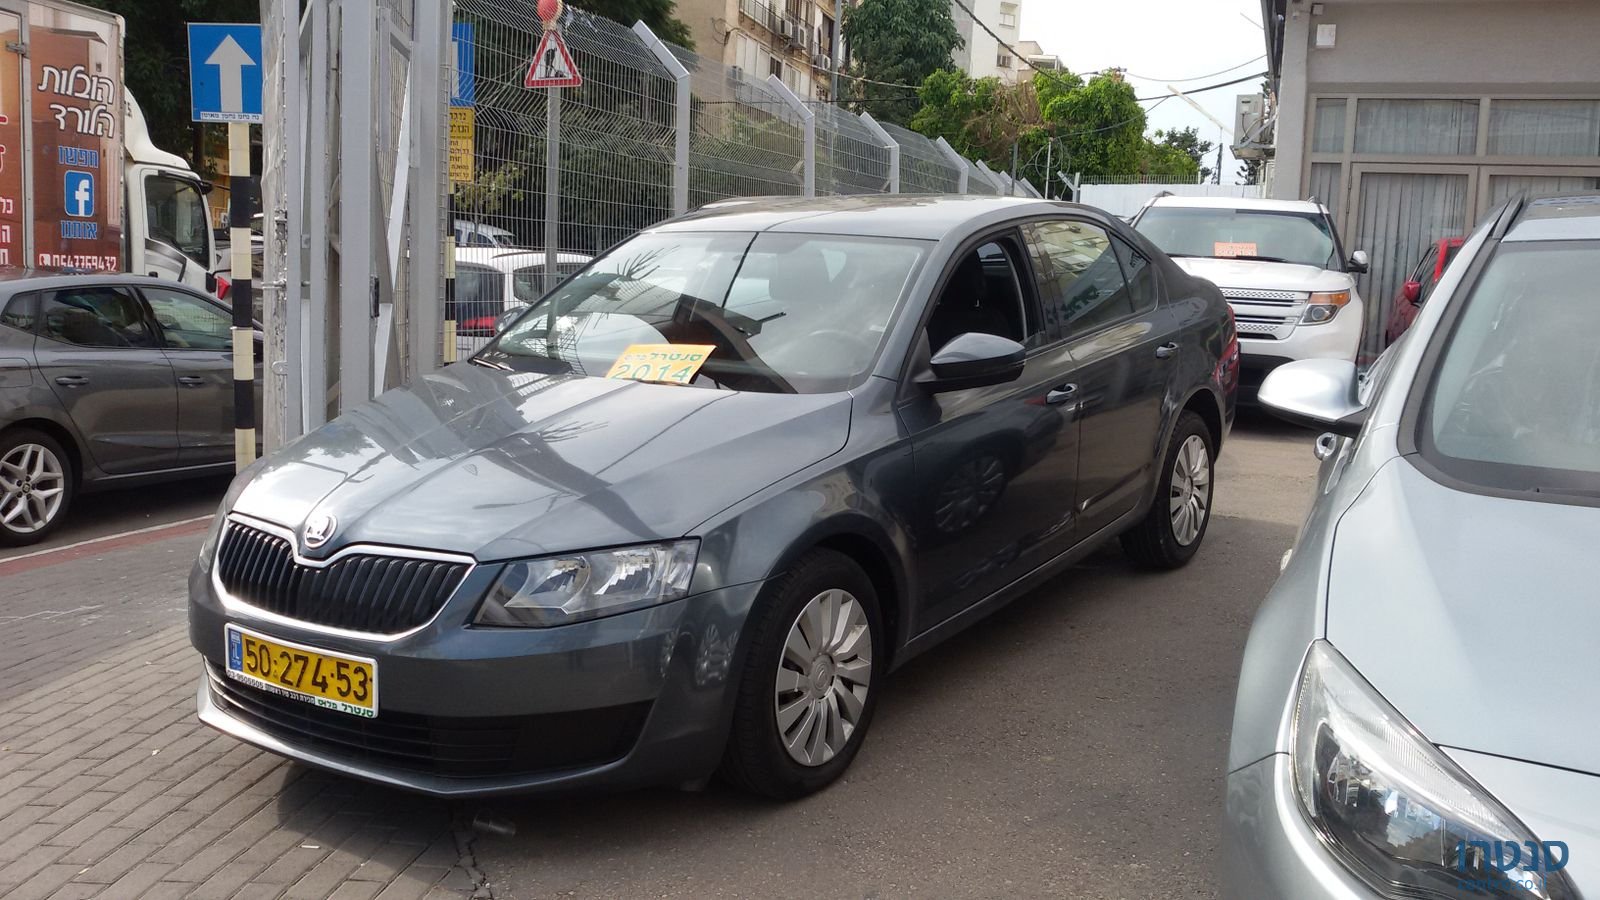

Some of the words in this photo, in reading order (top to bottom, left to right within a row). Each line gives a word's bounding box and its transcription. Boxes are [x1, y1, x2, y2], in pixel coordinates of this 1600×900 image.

[38, 65, 115, 104] הובלות
[50, 104, 115, 138] הלורד
[58, 145, 99, 168] חפשו
[60, 219, 98, 239] אותנו
[650, 352, 703, 361] סנטרל
[611, 364, 693, 380] 2014
[317, 698, 338, 710] פלוס
[342, 702, 374, 718] סנטרל
